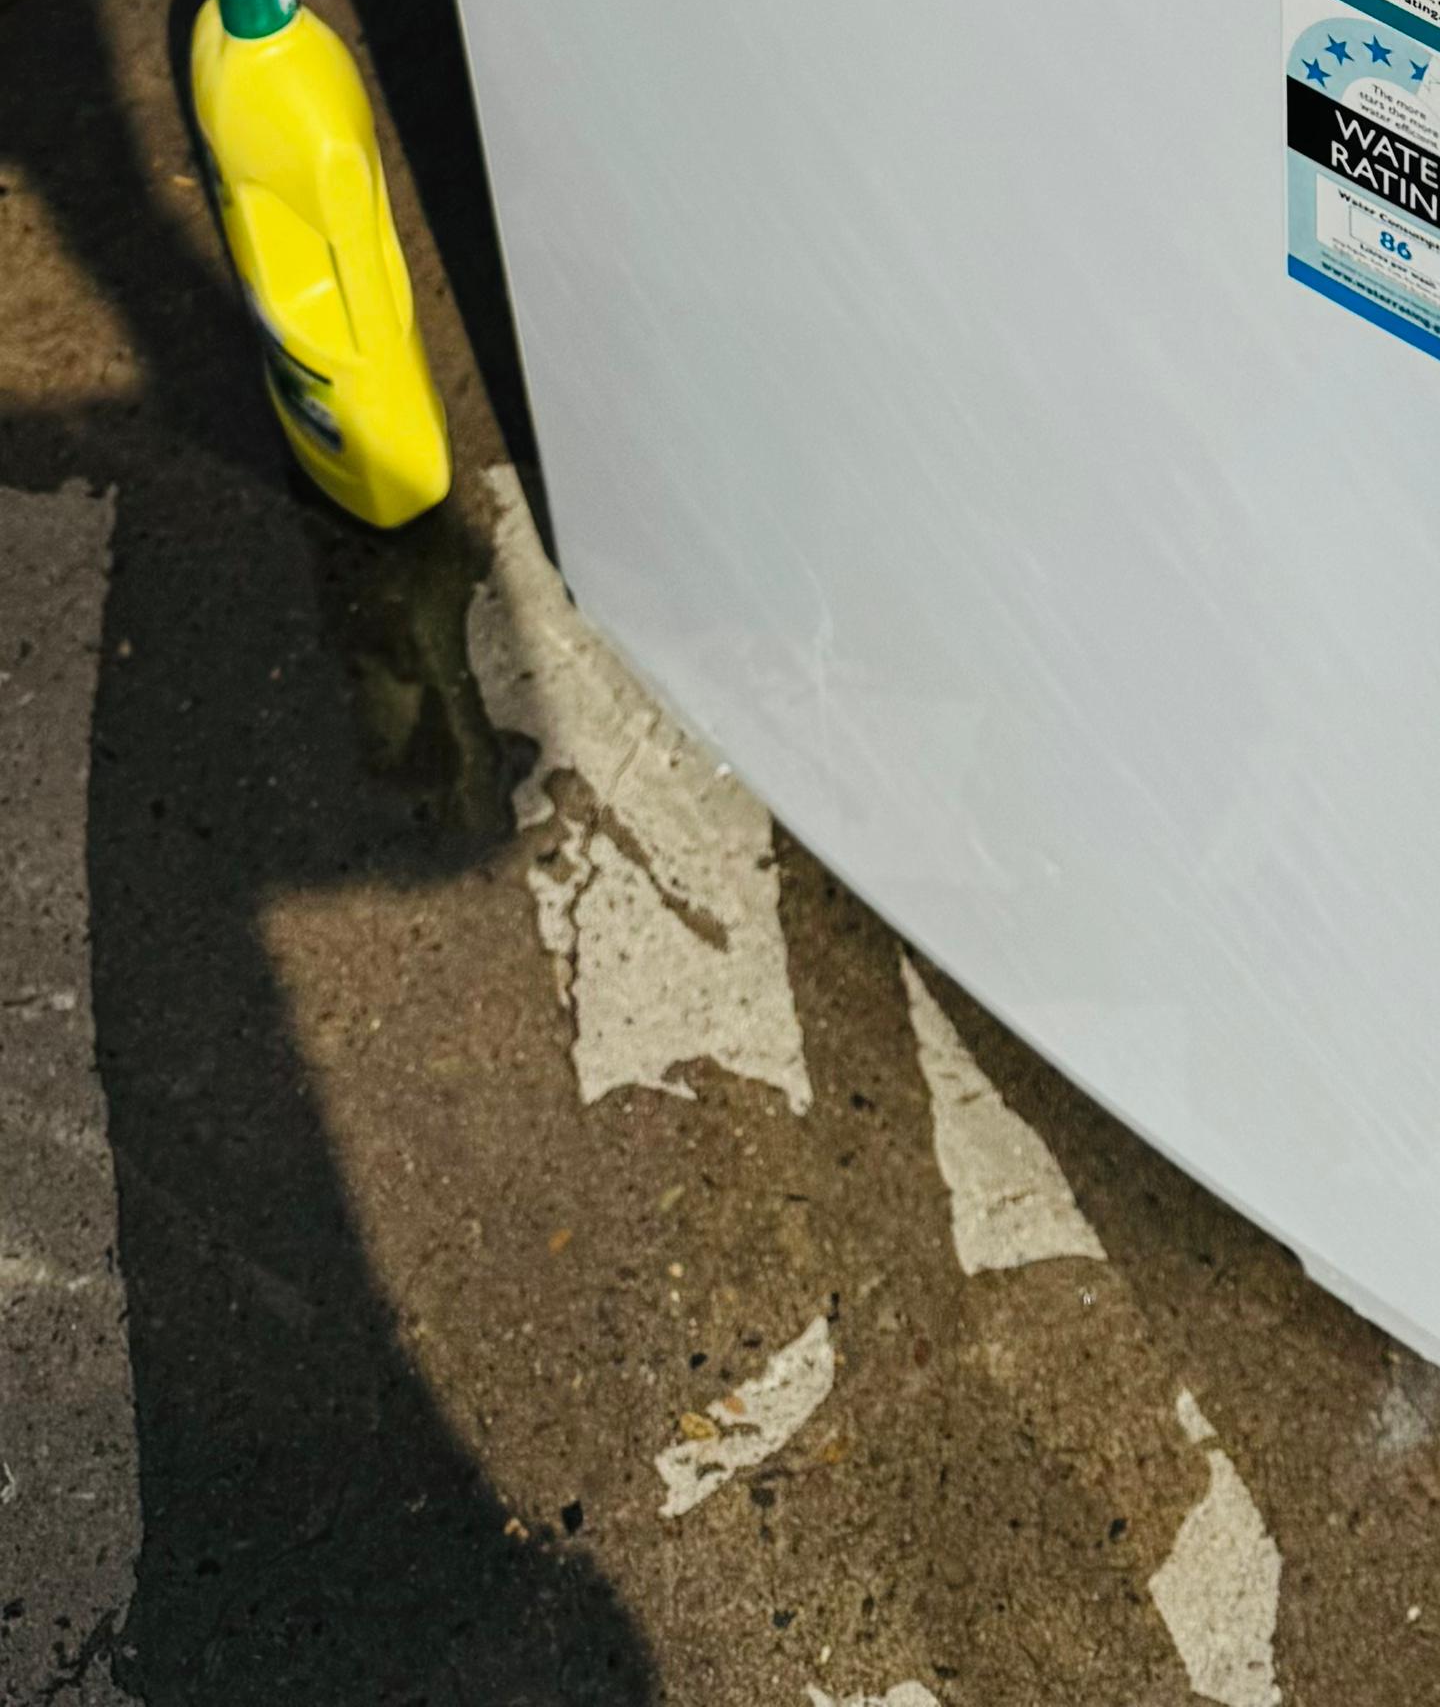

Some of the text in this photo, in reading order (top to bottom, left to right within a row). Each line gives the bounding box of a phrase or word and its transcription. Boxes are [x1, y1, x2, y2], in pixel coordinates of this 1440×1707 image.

[1359, 91, 1439, 139] stars the more
[1361, 105, 1391, 123] water
[1373, 85, 1427, 121] The more
[1338, 190, 1375, 215] Water
[1380, 231, 1412, 261] 86
